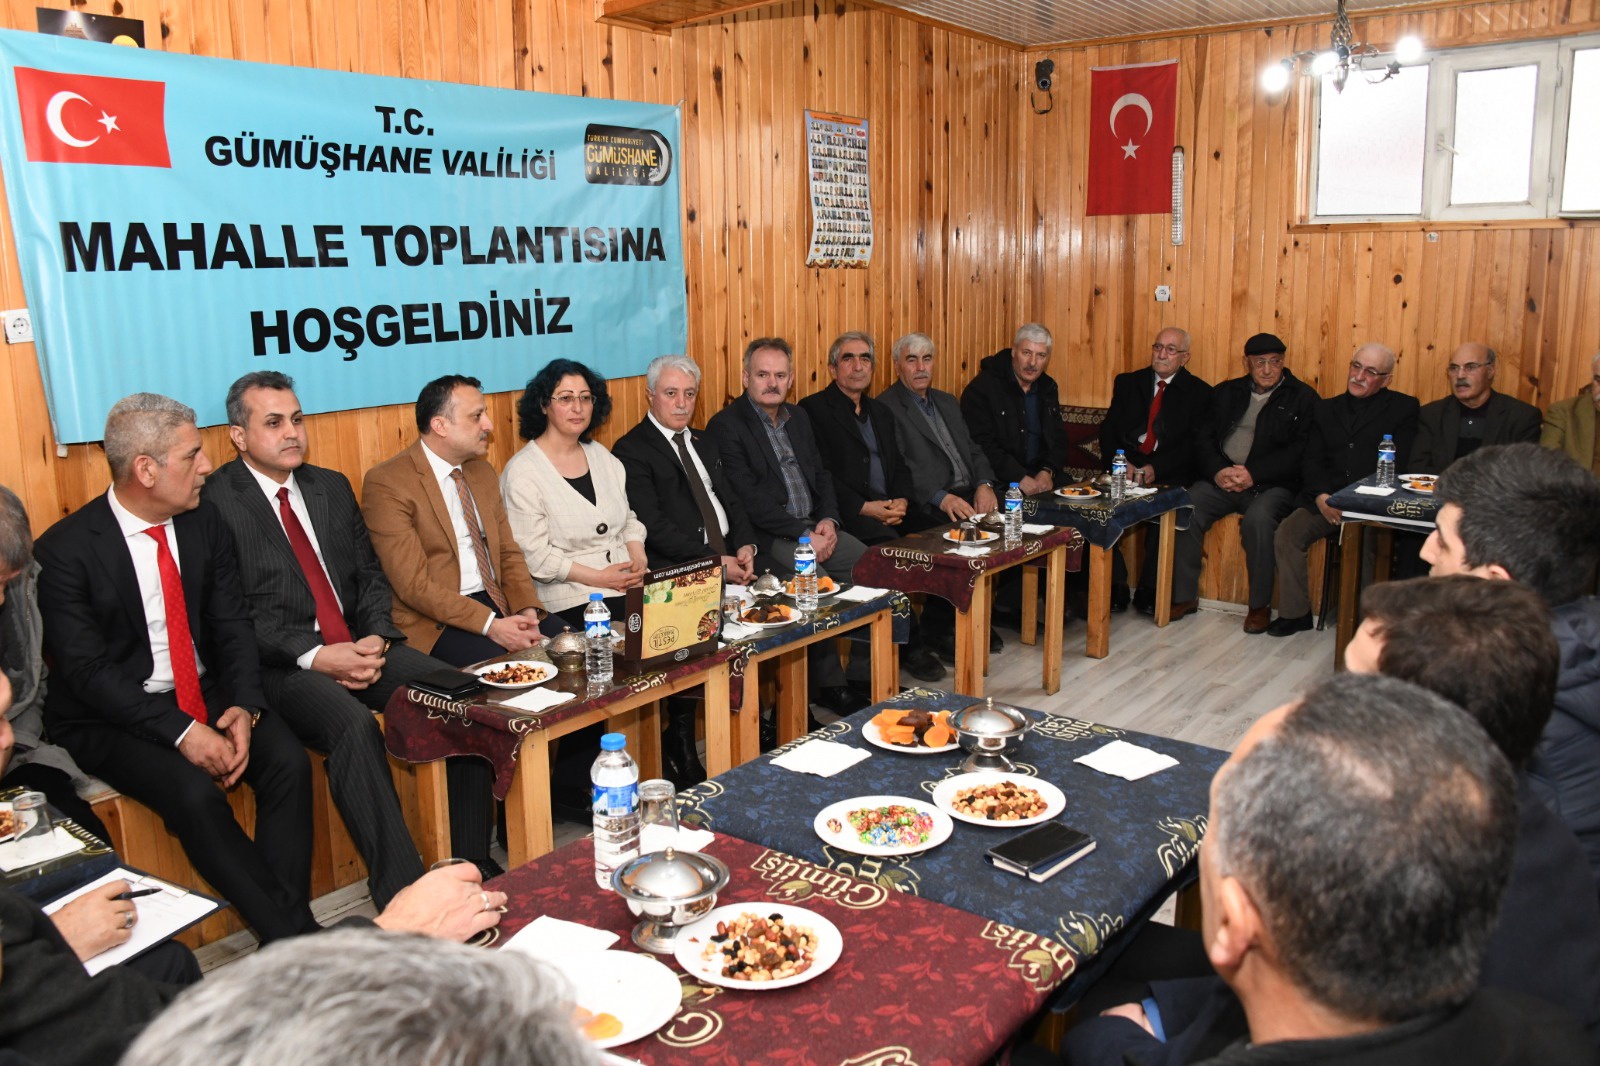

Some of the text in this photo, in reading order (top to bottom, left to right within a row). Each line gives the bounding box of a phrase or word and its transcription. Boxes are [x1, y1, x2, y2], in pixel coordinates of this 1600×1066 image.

[375, 106, 434, 136] T.C.
[204, 131, 557, 181] GÜMÜŞHANE VALİLİĞİ
[586, 144, 658, 168] GÜMÜŞHANE
[59, 222, 667, 272] MAHALLE TOPLANTISINA
[250, 289, 573, 362] HOŞGELDİNİZ
